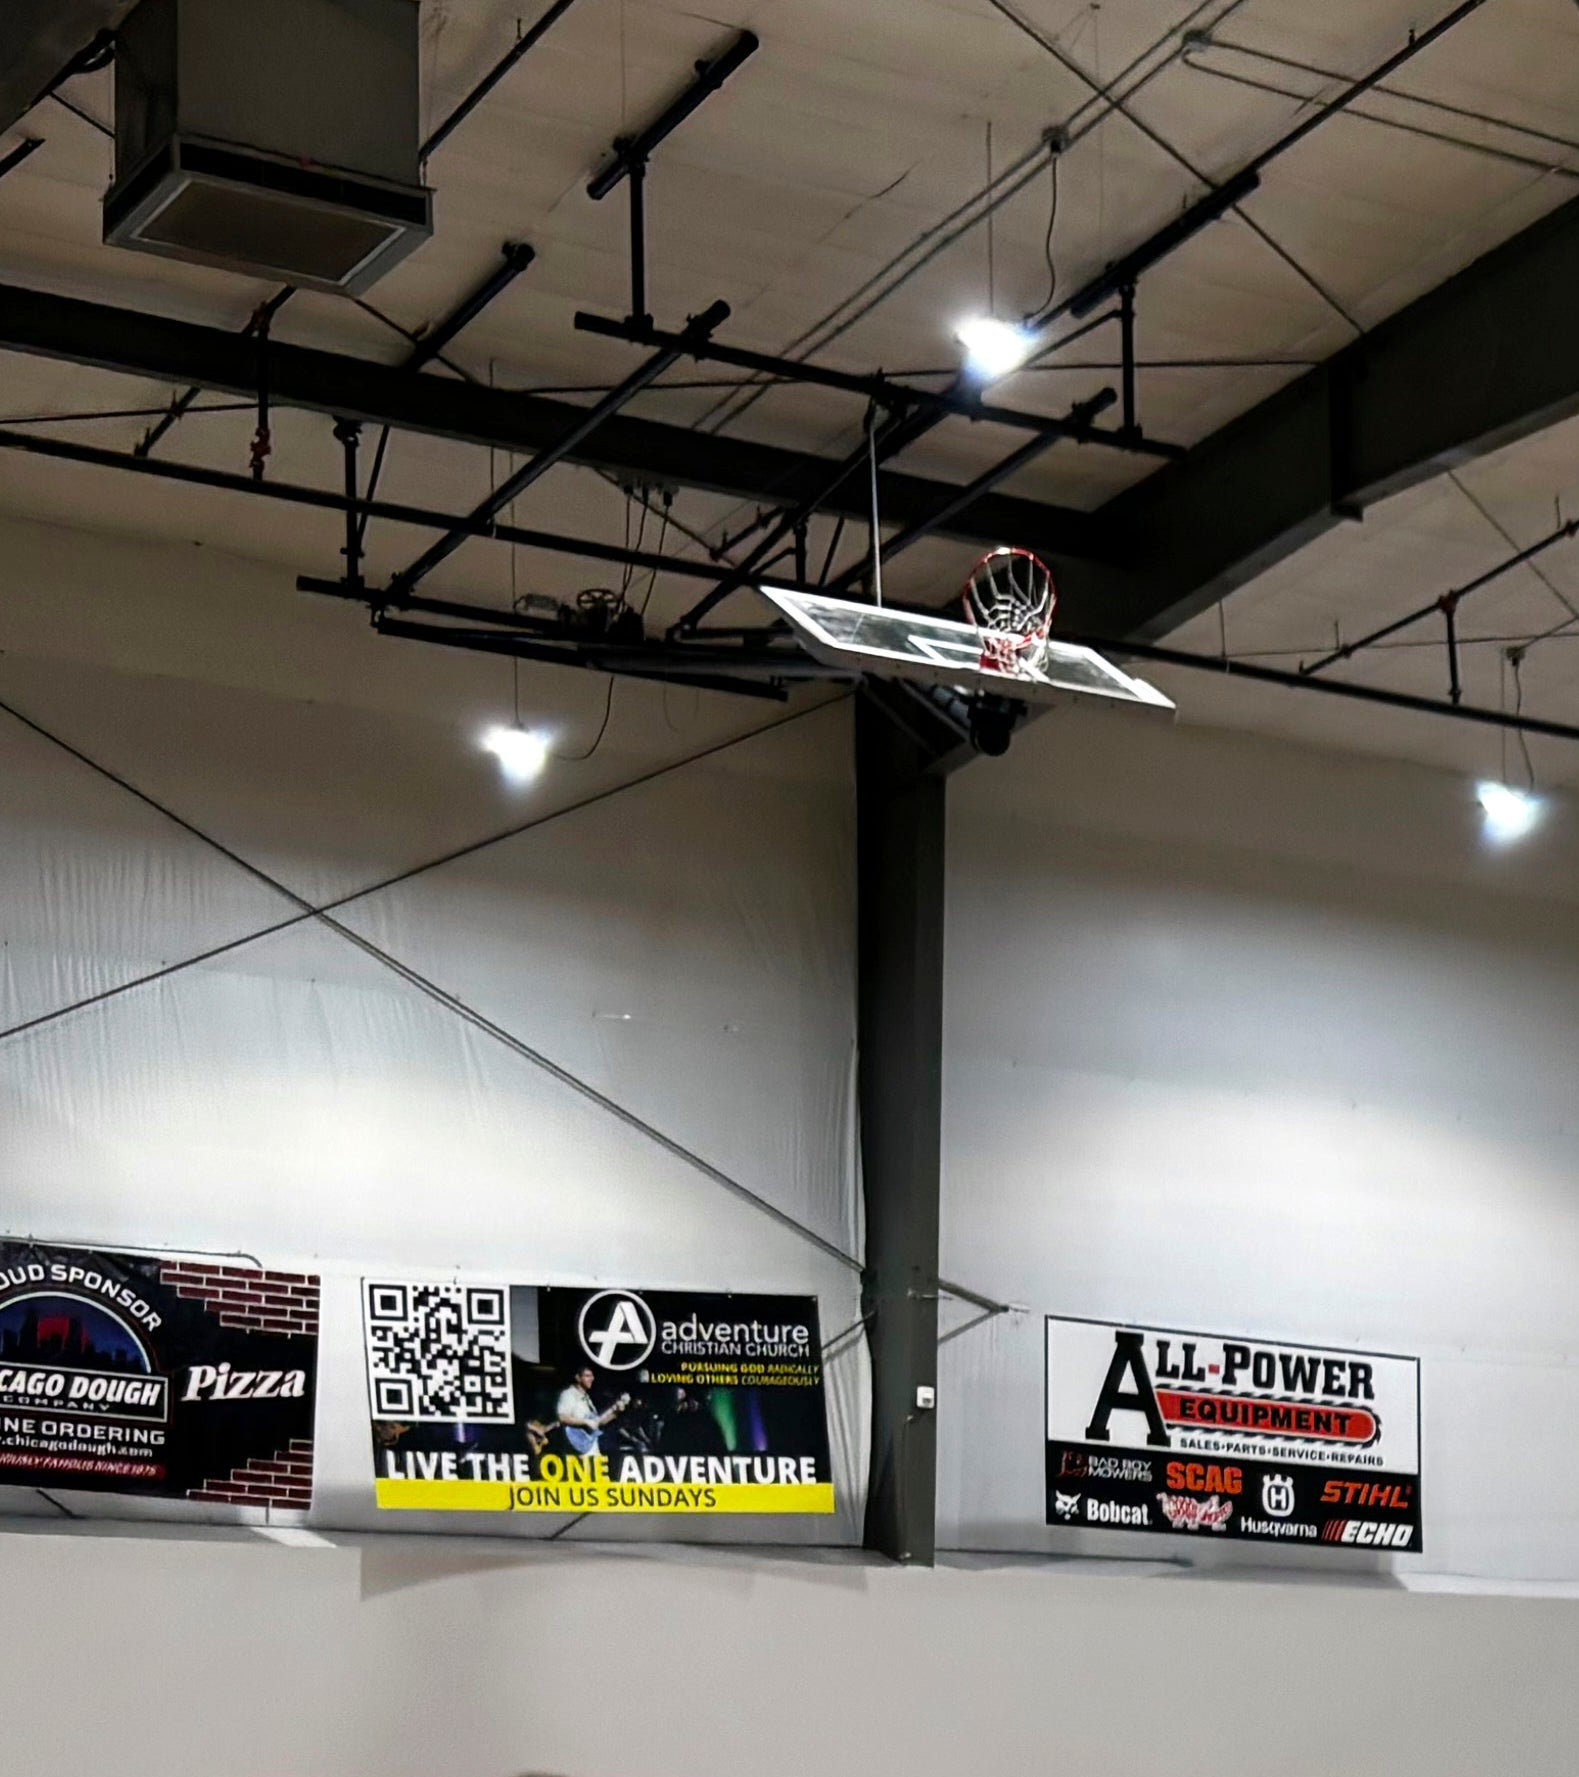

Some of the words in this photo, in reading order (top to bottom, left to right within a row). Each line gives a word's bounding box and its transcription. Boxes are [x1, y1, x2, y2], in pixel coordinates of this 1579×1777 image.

[51, 1264, 162, 1332] SPONSOR
[662, 1313, 809, 1343] adventure
[661, 1341, 741, 1355] CHRISTIAN
[746, 1343, 809, 1357] CHURCH
[651, 1373, 693, 1384] LOVING
[696, 1375, 738, 1385] OTHERS
[681, 1362, 737, 1373] PURSUING
[741, 1363, 764, 1373] GOD
[68, 1376, 161, 1406] DOUGH
[181, 1362, 305, 1402] Pizza
[3, 1395, 110, 1411] COMPANY
[0, 1417, 36, 1433] NE
[41, 1420, 165, 1445] ORDERING
[1179, 1400, 1353, 1435] EQUIPMENT
[385, 1450, 458, 1481] LIVE
[468, 1453, 530, 1482] THE
[540, 1453, 609, 1482] ONE
[619, 1455, 816, 1484] ADVENTURE
[1088, 1455, 1118, 1468] BAD
[1122, 1458, 1152, 1471] BOY
[1088, 1467, 1153, 1482] MOWERS
[1166, 1461, 1242, 1494] SCAG
[508, 1487, 561, 1509] JOIN
[569, 1487, 598, 1506] US
[606, 1488, 716, 1508] SUNDAYS
[1320, 1480, 1408, 1509] STIHL
[1087, 1498, 1149, 1525] Bobcat
[1241, 1516, 1318, 1538] Husqvarna
[1341, 1520, 1414, 1547] ECHO
